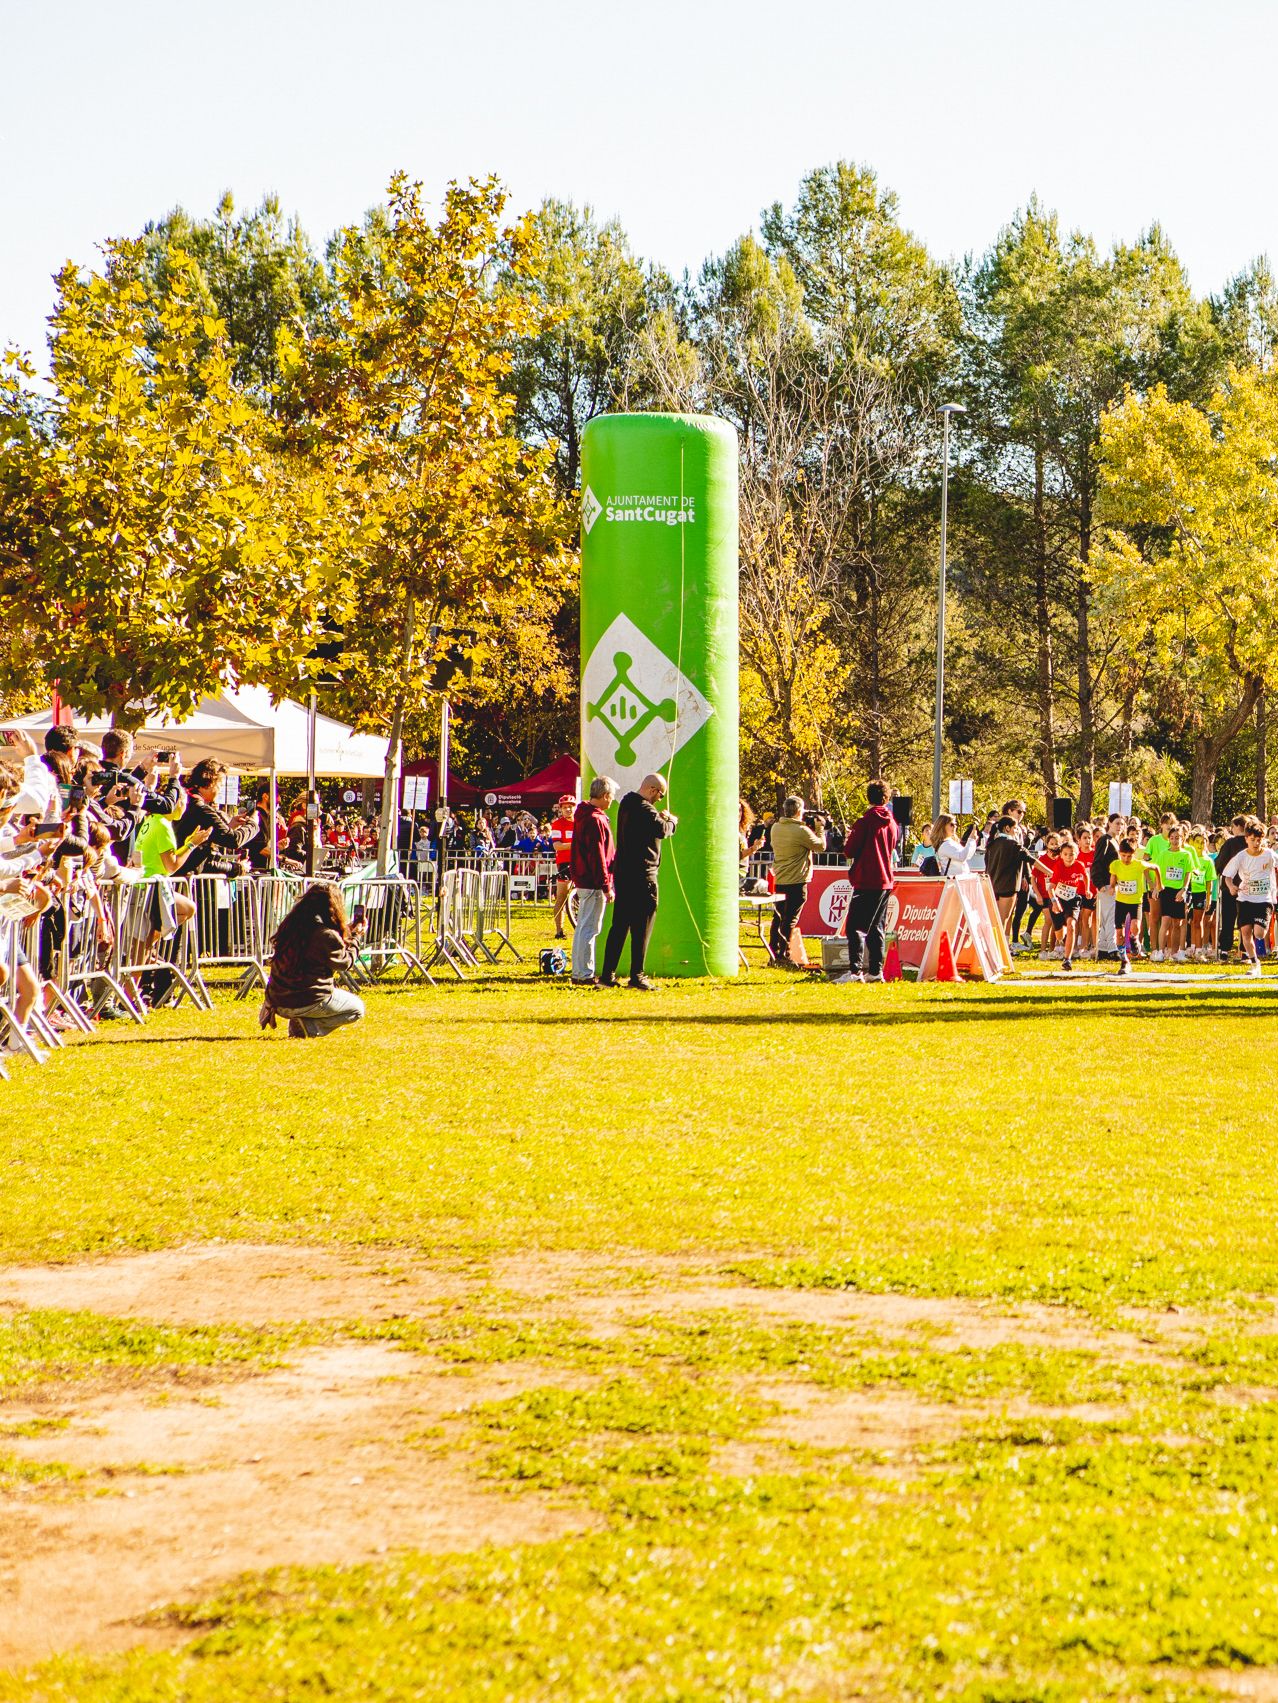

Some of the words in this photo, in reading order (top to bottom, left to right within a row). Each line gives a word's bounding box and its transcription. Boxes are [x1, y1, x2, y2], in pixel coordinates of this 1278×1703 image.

[606, 495, 678, 506] AJUNTAMENT
[682, 496, 695, 507] DE
[606, 506, 695, 526] SantCugat
[133, 743, 141, 751] de
[902, 904, 938, 924] Diputac
[898, 925, 931, 942] Barcelo
